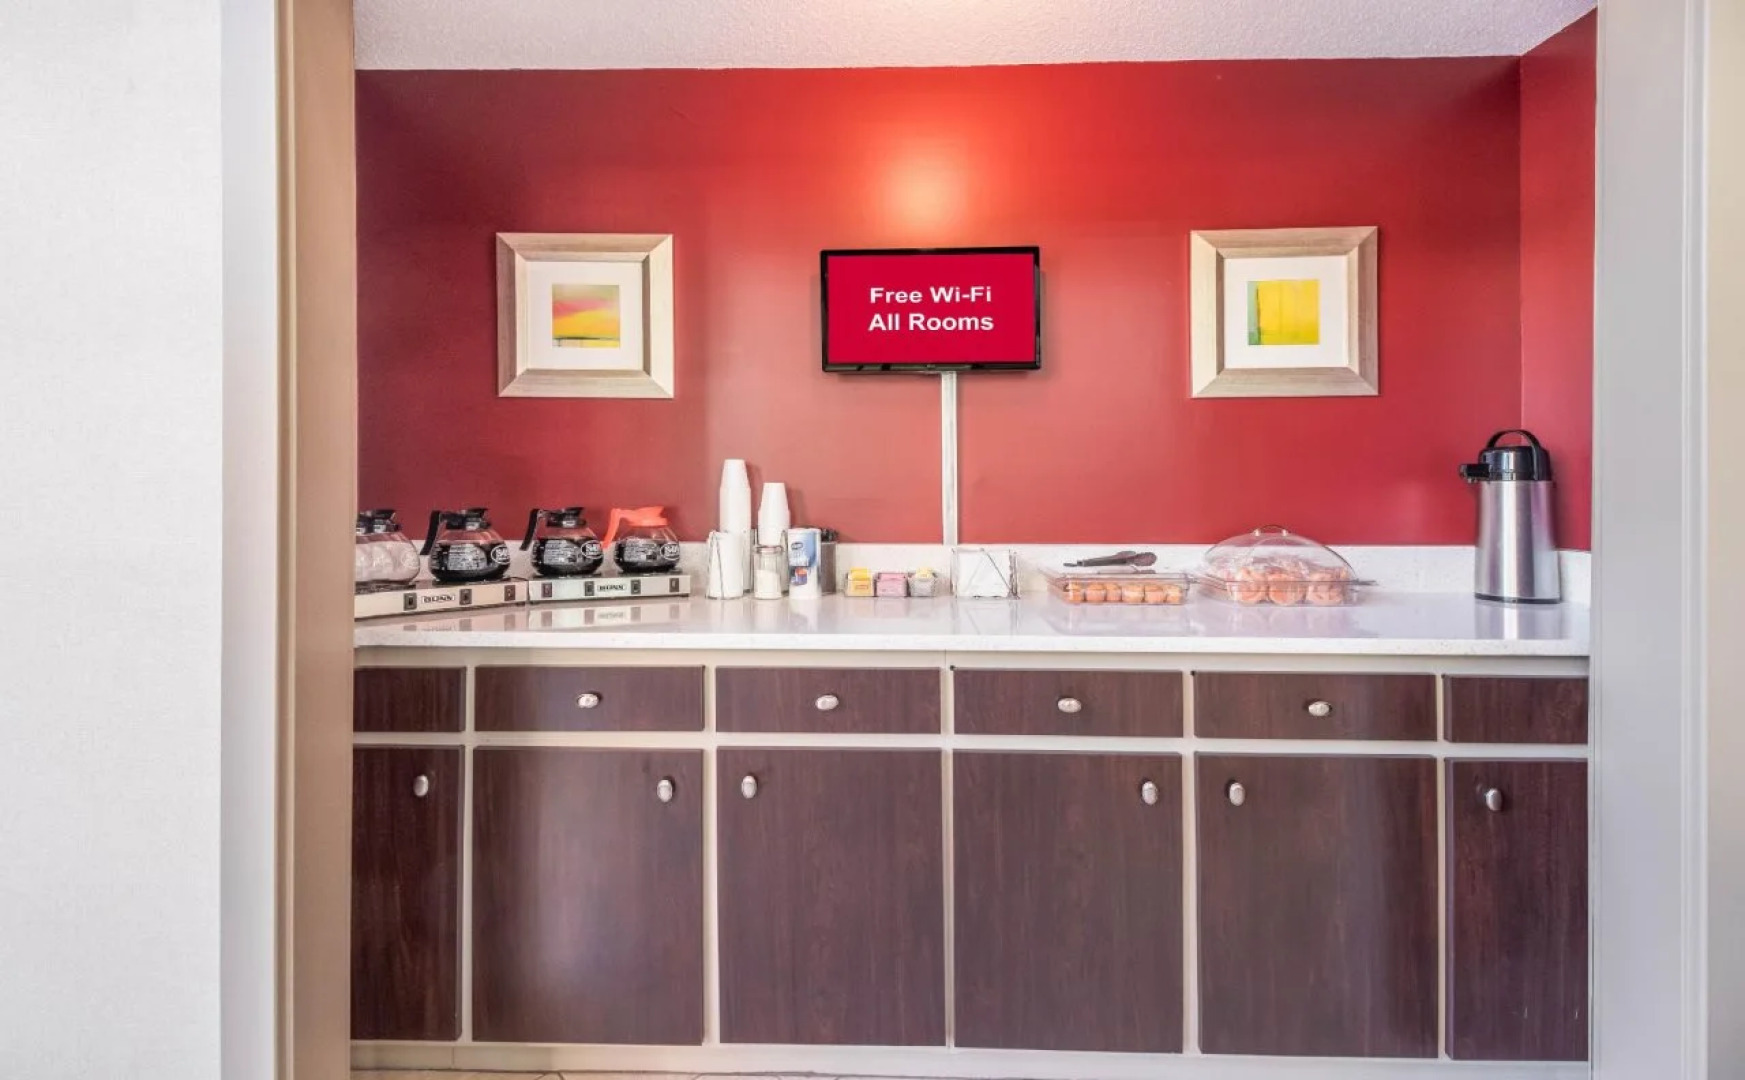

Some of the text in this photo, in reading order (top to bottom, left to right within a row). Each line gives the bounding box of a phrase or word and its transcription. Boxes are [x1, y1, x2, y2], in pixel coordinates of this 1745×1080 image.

[870, 286, 992, 304] Free Wi-Fi
[868, 313, 994, 331] All Rooms
